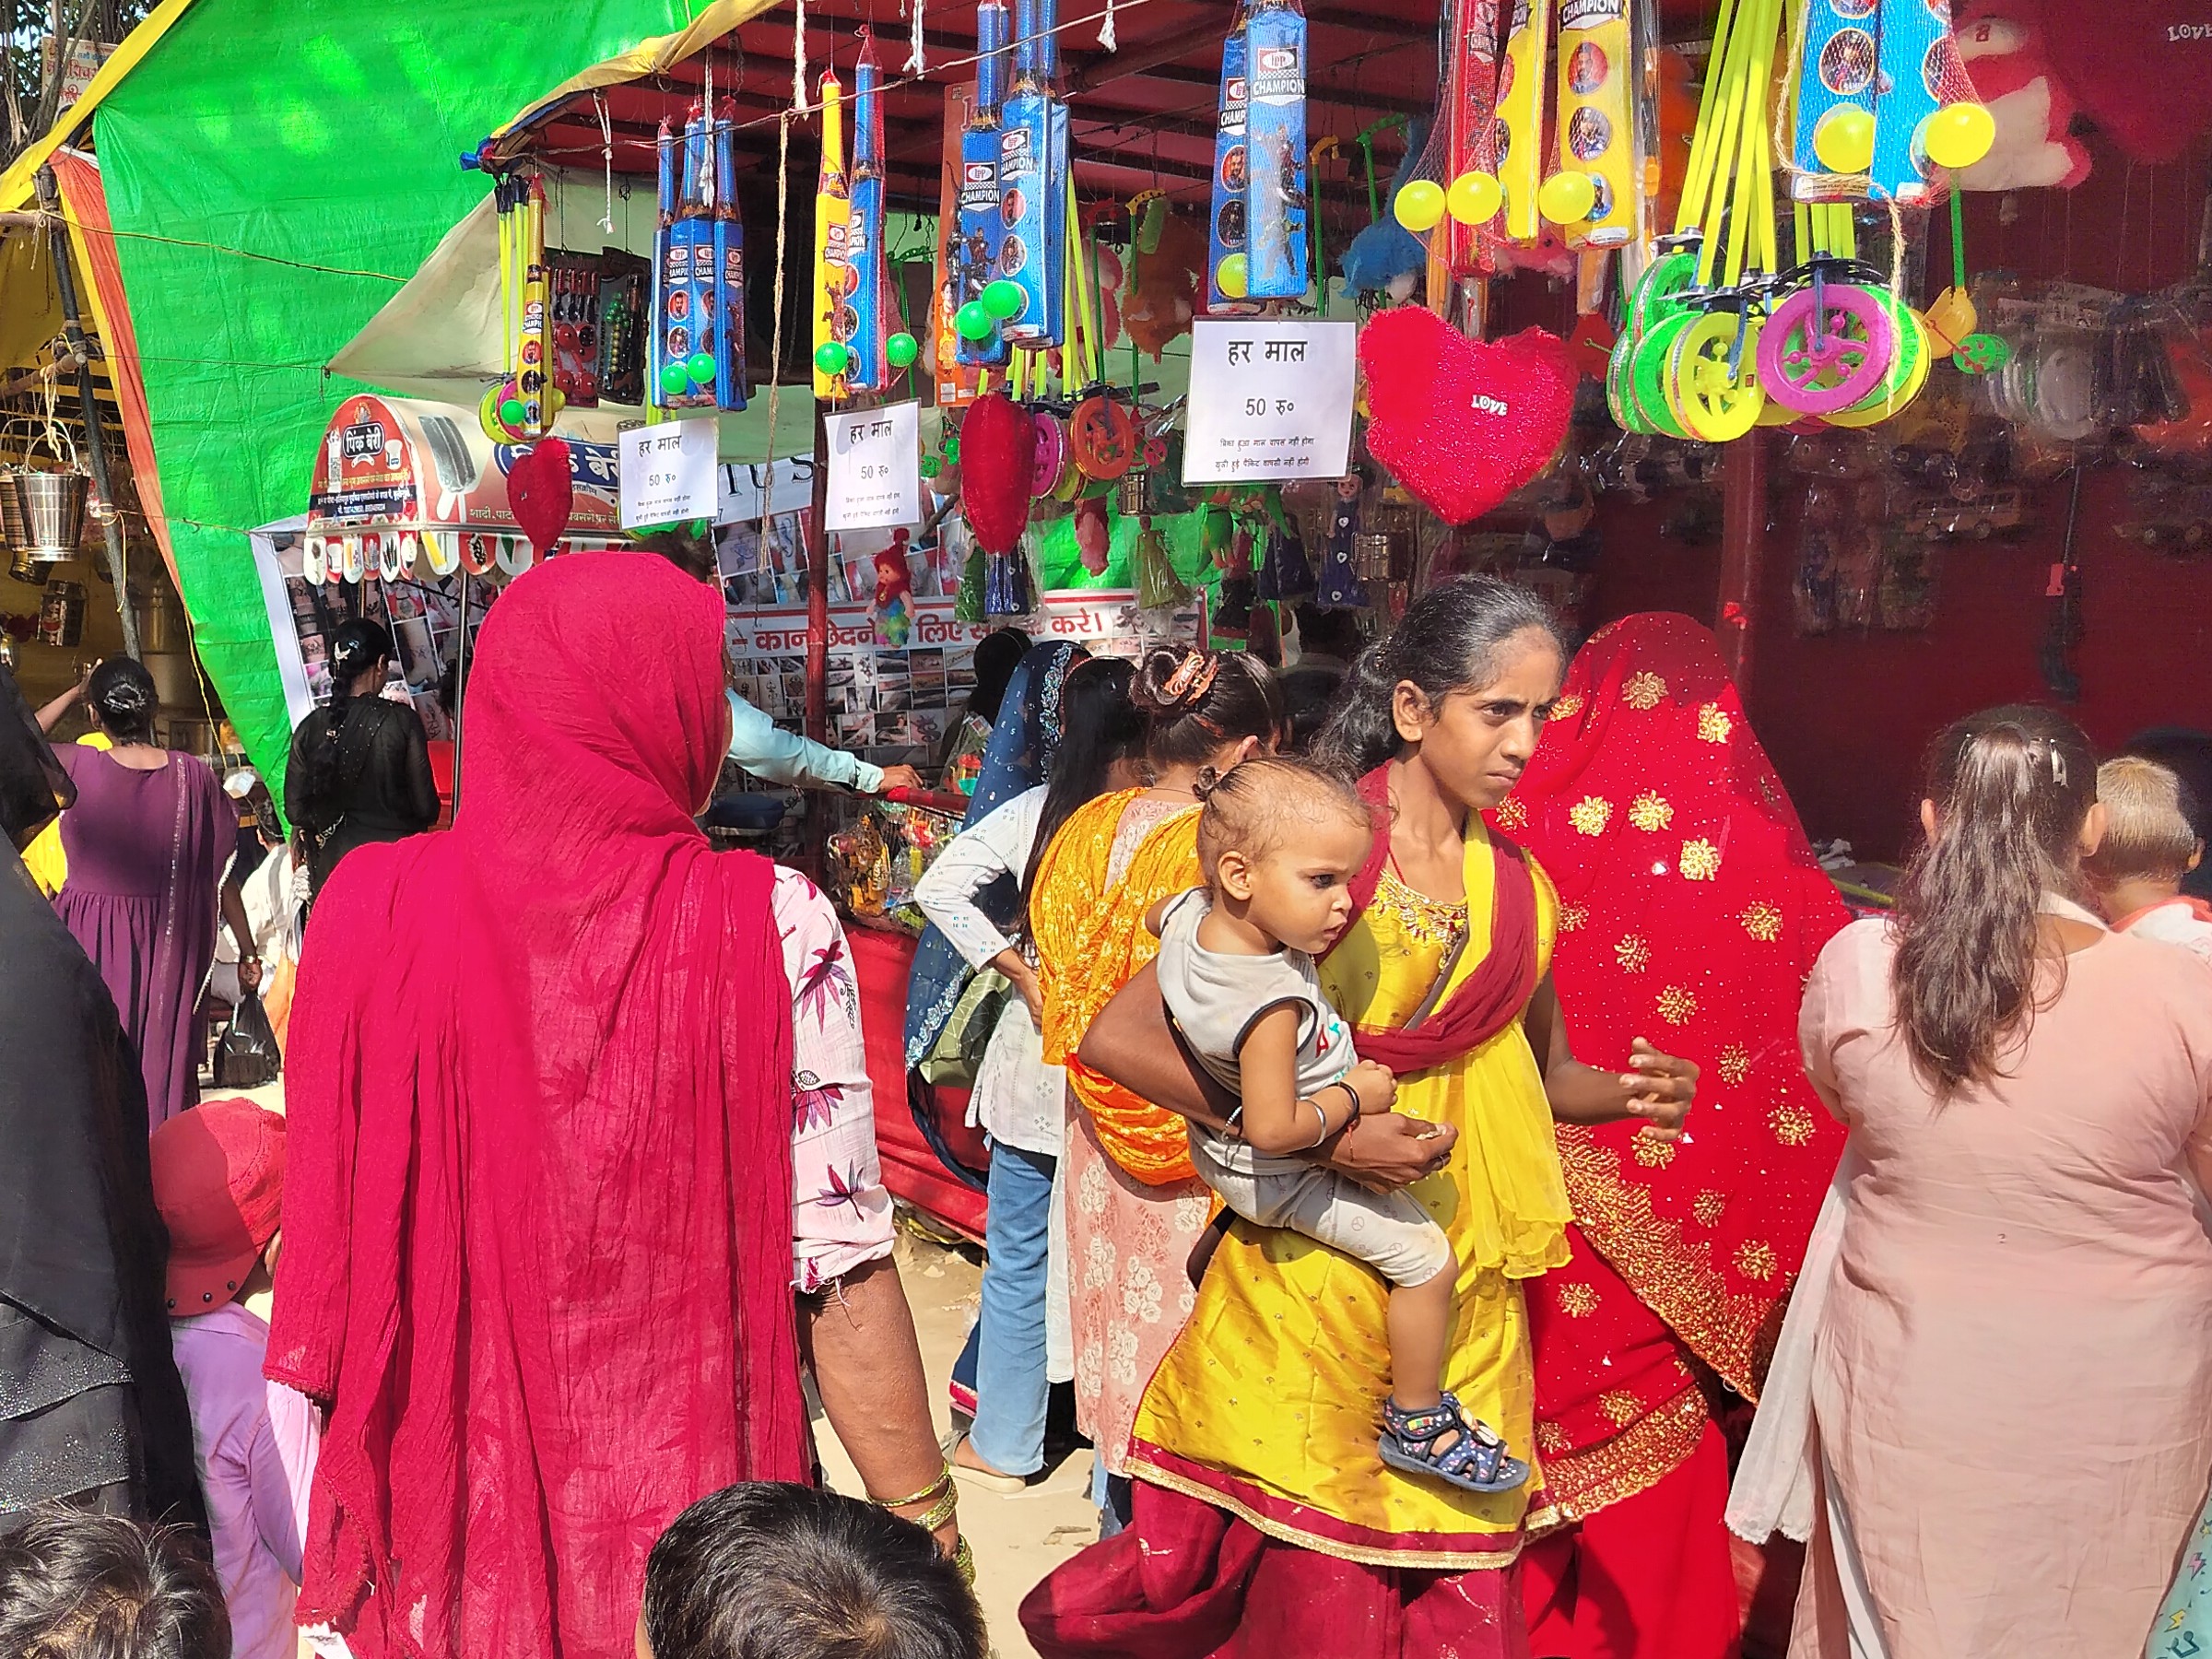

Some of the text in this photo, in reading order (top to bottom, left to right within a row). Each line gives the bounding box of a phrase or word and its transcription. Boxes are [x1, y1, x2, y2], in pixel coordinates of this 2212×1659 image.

[1562, 0, 1619, 22] CHAMPION
[1253, 78, 1306, 95] CHAMPION
[1220, 111, 1246, 127] CHAMP
[960, 189, 1000, 204] CHAMPION
[1228, 340, 1308, 366] हर माल
[1245, 398, 1266, 416] 50
[1470, 394, 1509, 416] LOVE
[850, 419, 893, 444] हर माल
[638, 434, 682, 457] हर माल
[861, 465, 874, 479] 50
